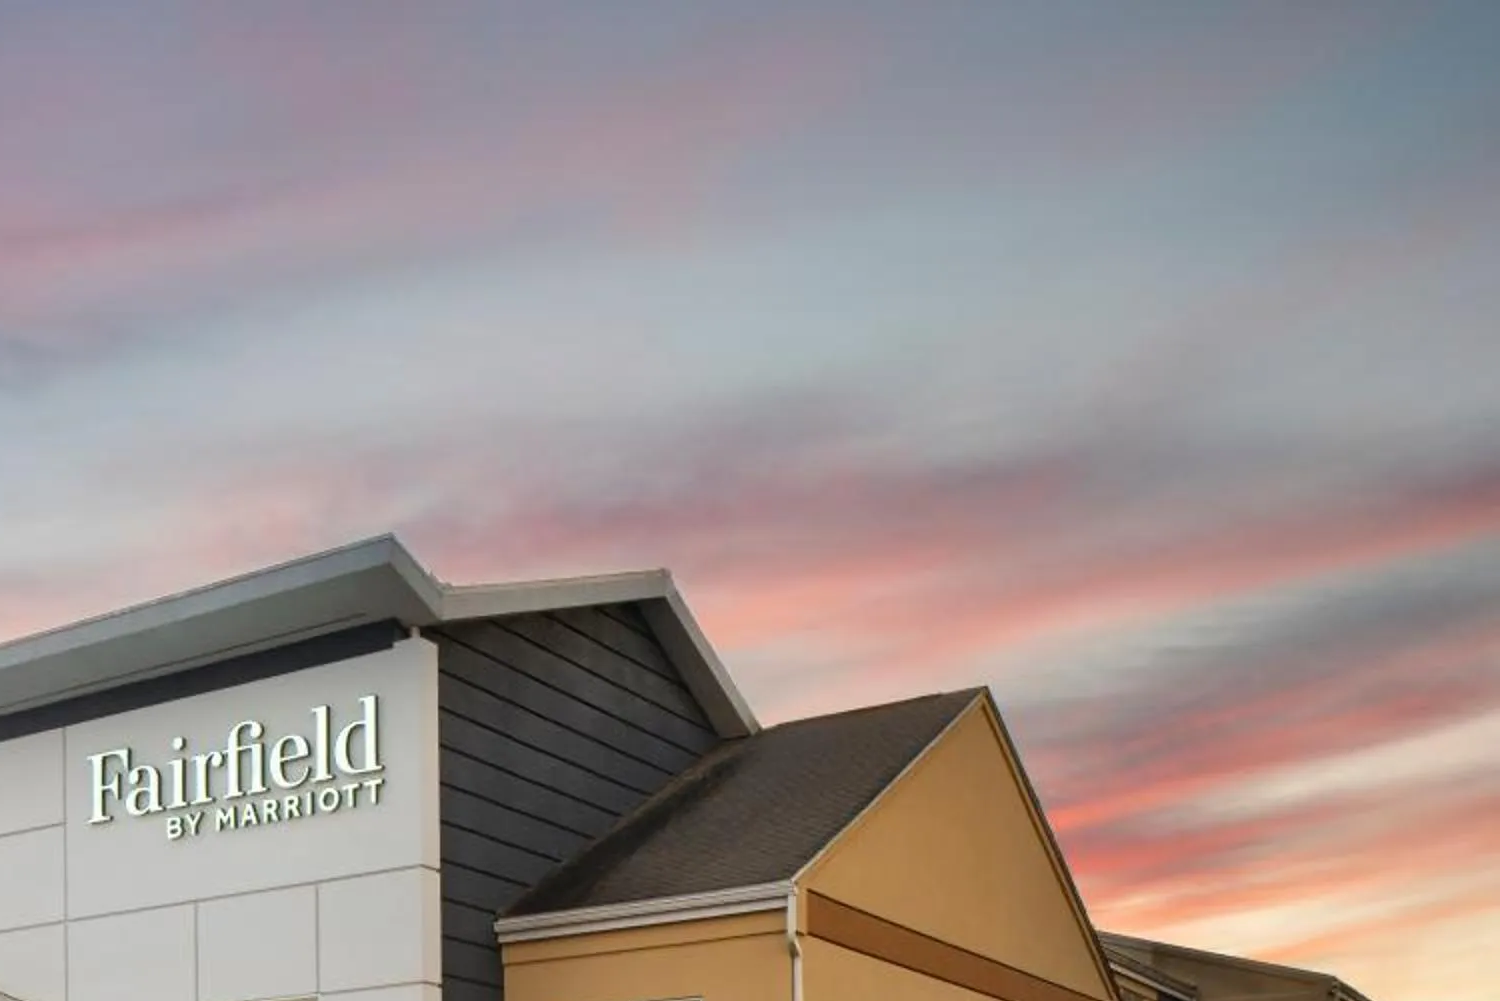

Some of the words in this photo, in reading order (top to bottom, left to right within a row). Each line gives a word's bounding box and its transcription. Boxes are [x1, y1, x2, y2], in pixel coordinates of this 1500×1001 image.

[86, 694, 385, 825] Fairfield
[166, 811, 204, 841] BY
[215, 779, 385, 833] MARRIOTT
